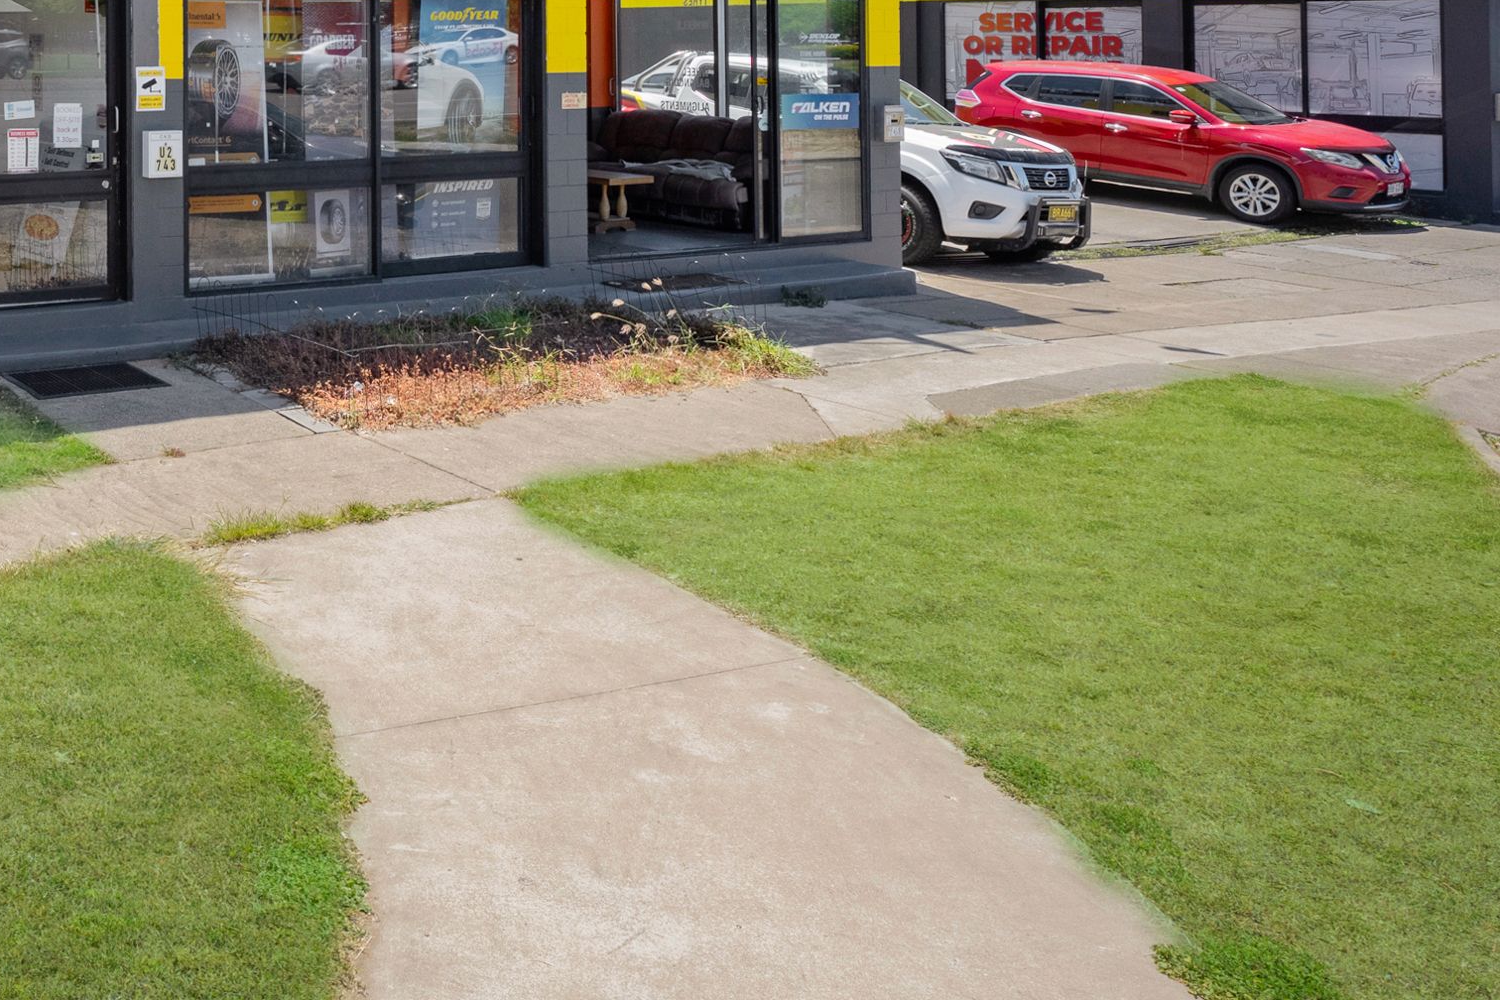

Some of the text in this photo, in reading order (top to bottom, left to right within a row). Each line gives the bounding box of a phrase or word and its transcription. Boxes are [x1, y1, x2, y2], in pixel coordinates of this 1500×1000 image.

[430, 7, 500, 23] GOODYEAR
[978, 11, 1105, 33] SERVICE
[963, 35, 1004, 56] OR
[791, 101, 850, 114] FALKEN
[225, 136, 232, 144] 6
[156, 159, 176, 171] 743
[433, 179, 494, 193] INSPIRED
